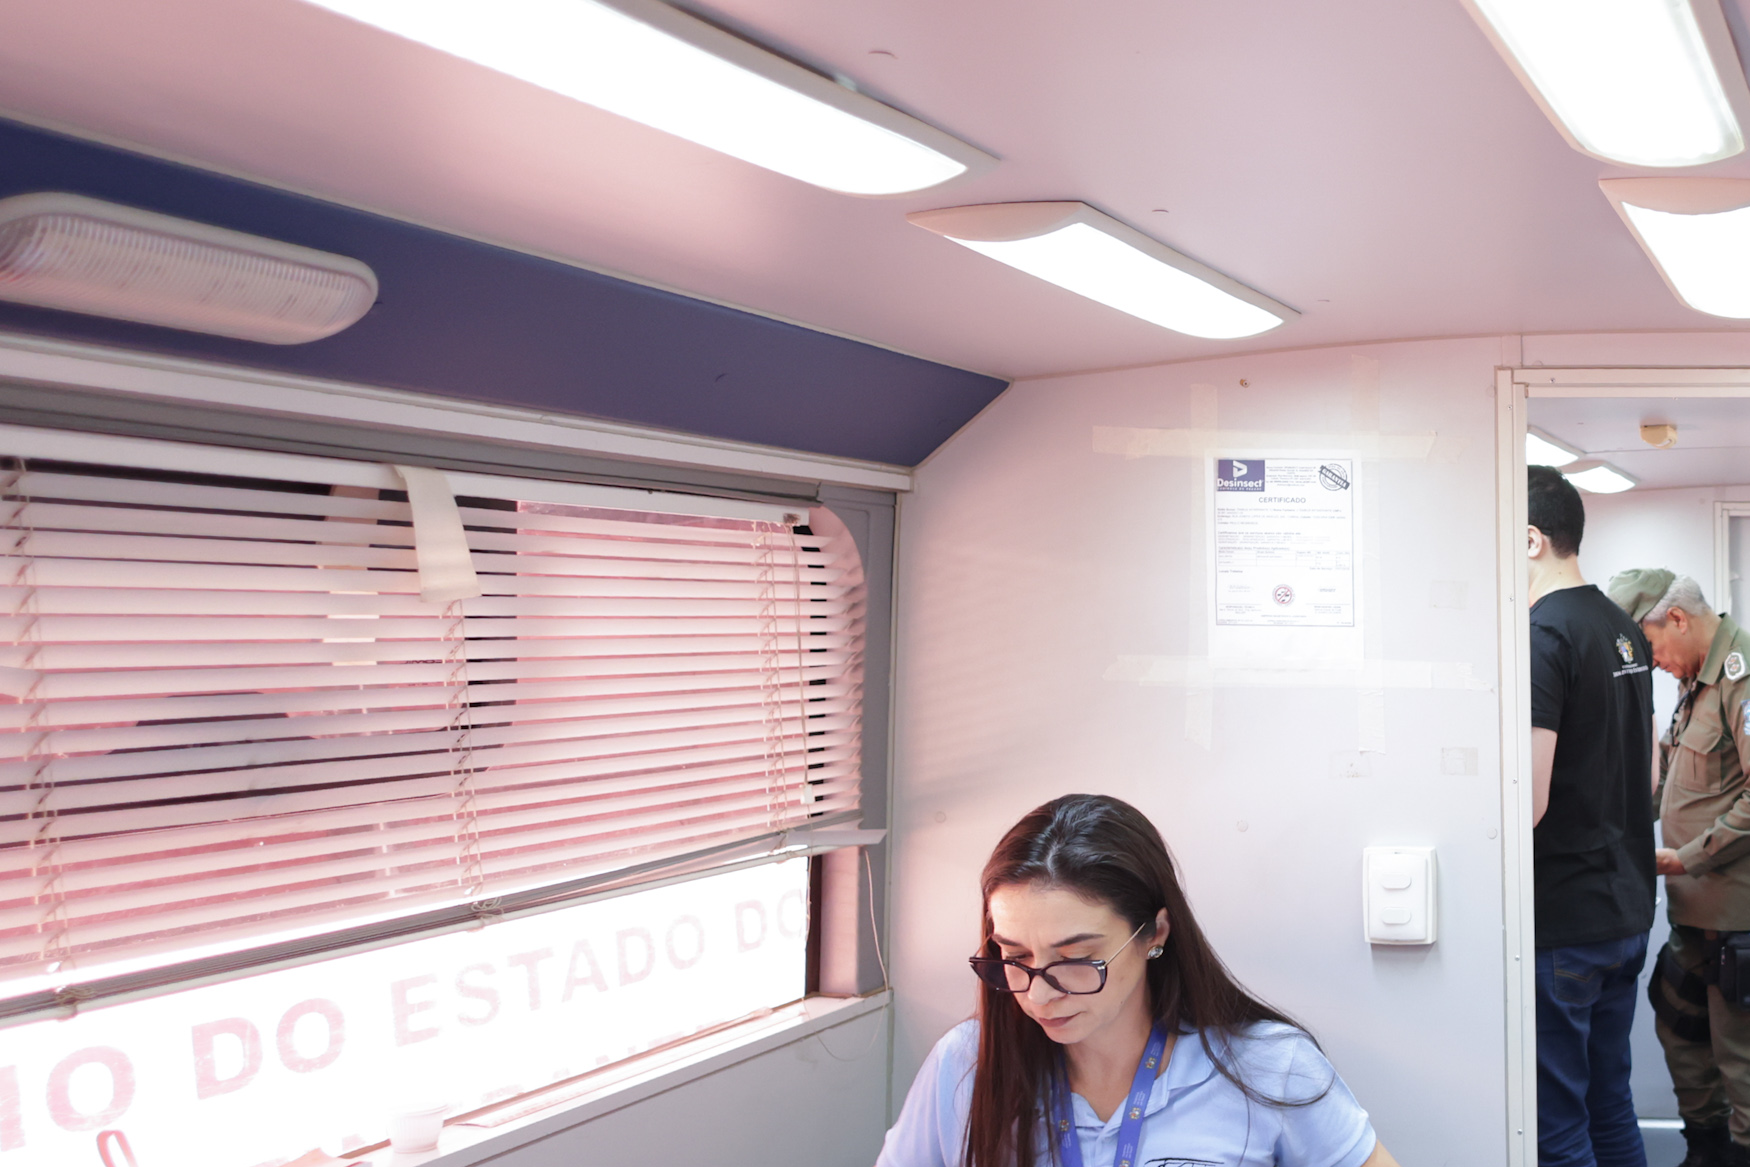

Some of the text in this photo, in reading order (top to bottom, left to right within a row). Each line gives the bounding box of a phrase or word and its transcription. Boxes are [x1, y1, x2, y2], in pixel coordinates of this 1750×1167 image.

[1217, 478, 1262, 488] Desinsect
[191, 997, 346, 1100] DO
[390, 914, 706, 1049] ESTADO
